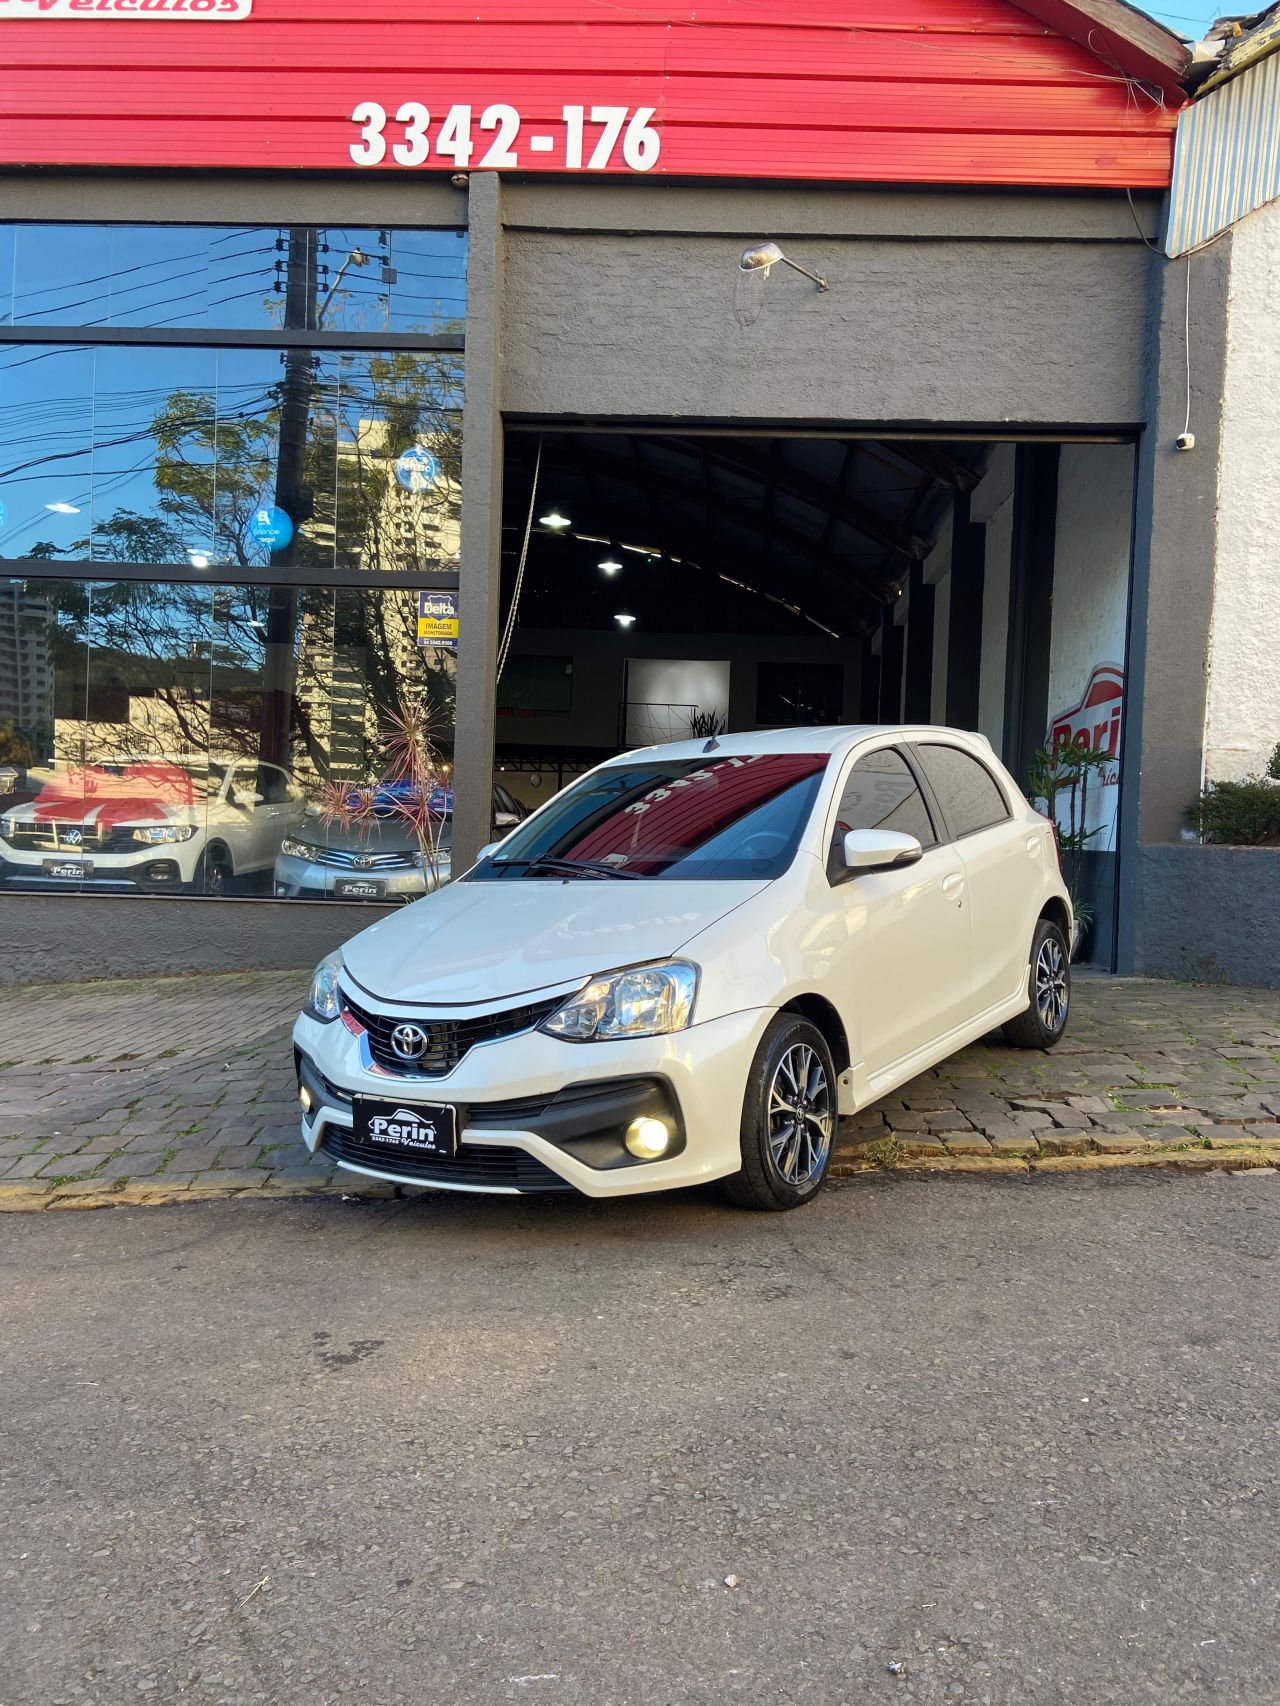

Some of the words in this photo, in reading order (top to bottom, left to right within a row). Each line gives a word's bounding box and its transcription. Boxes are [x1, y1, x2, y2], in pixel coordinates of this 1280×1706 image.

[349, 101, 661, 171] 3342-176
[424, 602, 455, 615] Delta
[426, 622, 452, 630] IMAGEM
[373, 1118, 435, 1142] Perin
